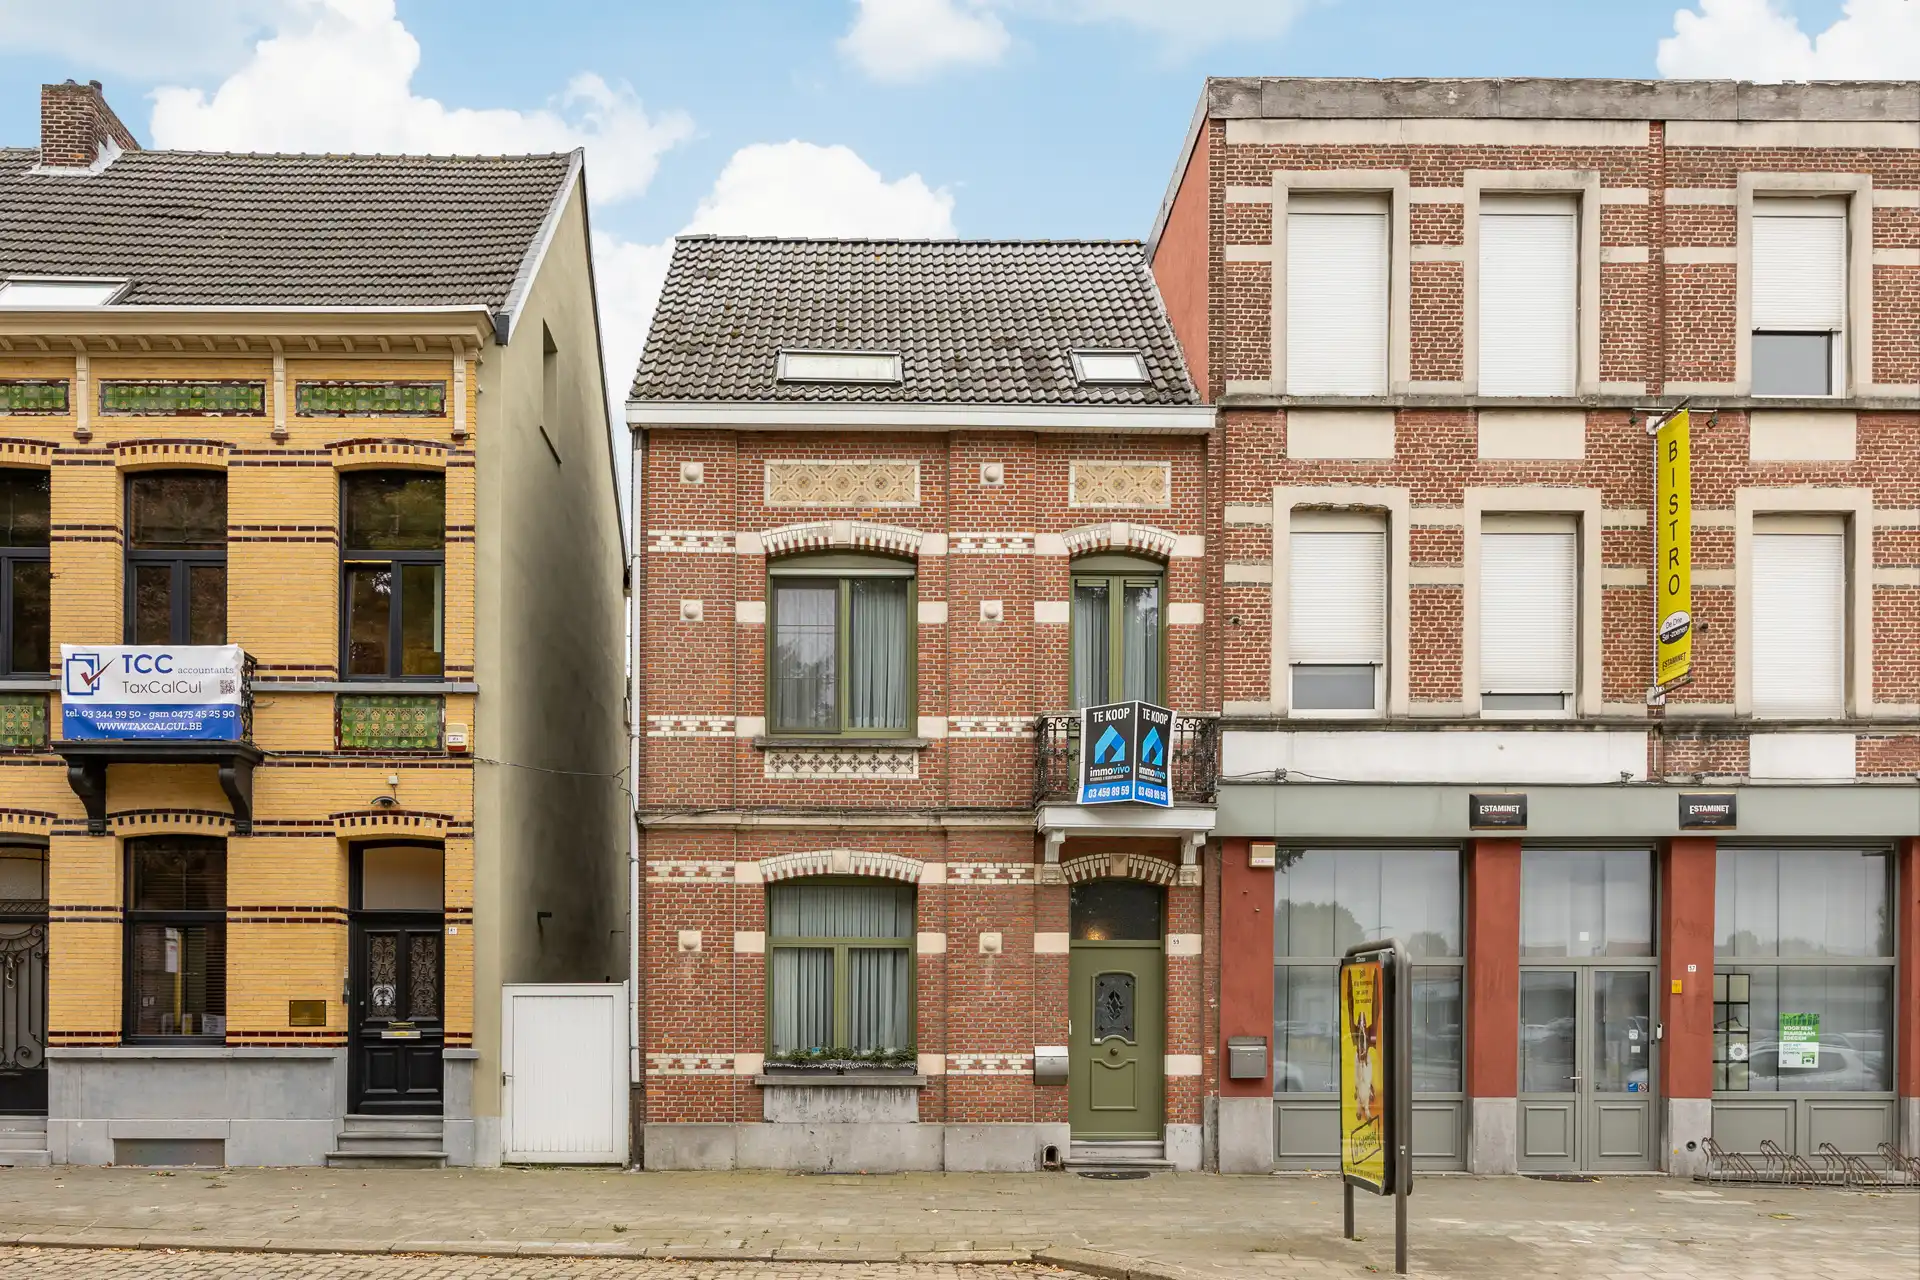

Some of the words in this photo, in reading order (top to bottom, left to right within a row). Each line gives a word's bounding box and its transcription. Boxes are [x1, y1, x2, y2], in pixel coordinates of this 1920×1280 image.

[1669, 440, 1680, 595] BISTRO
[122, 654, 173, 674] TCC
[178, 666, 234, 674] accountants
[122, 680, 202, 694] TaxCalCul
[65, 709, 80, 717] tel.
[82, 711, 94, 719] 03
[96, 711, 113, 719] 344
[115, 711, 127, 719] 99
[129, 711, 141, 719] 50
[149, 711, 169, 719] gsm
[171, 710, 194, 719] 0475
[195, 710, 207, 719] 45
[209, 710, 221, 719] 25
[222, 710, 235, 719] 90
[1093, 711, 1104, 723] TE
[1105, 708, 1130, 721] KOOP
[1142, 708, 1150, 720] TE
[1150, 710, 1168, 725] KOOP
[96, 722, 203, 731] WWW.TAXCALCUL.BE
[1090, 764, 1130, 777] immovivo
[1139, 763, 1166, 779] immovivo
[1088, 788, 1097, 799] 03
[1098, 787, 1111, 797] 459
[1111, 786, 1120, 796] 89
[1120, 785, 1130, 795] 59
[1480, 804, 1521, 815] ESTAMINET
[1689, 804, 1730, 815] ESTAMINET
